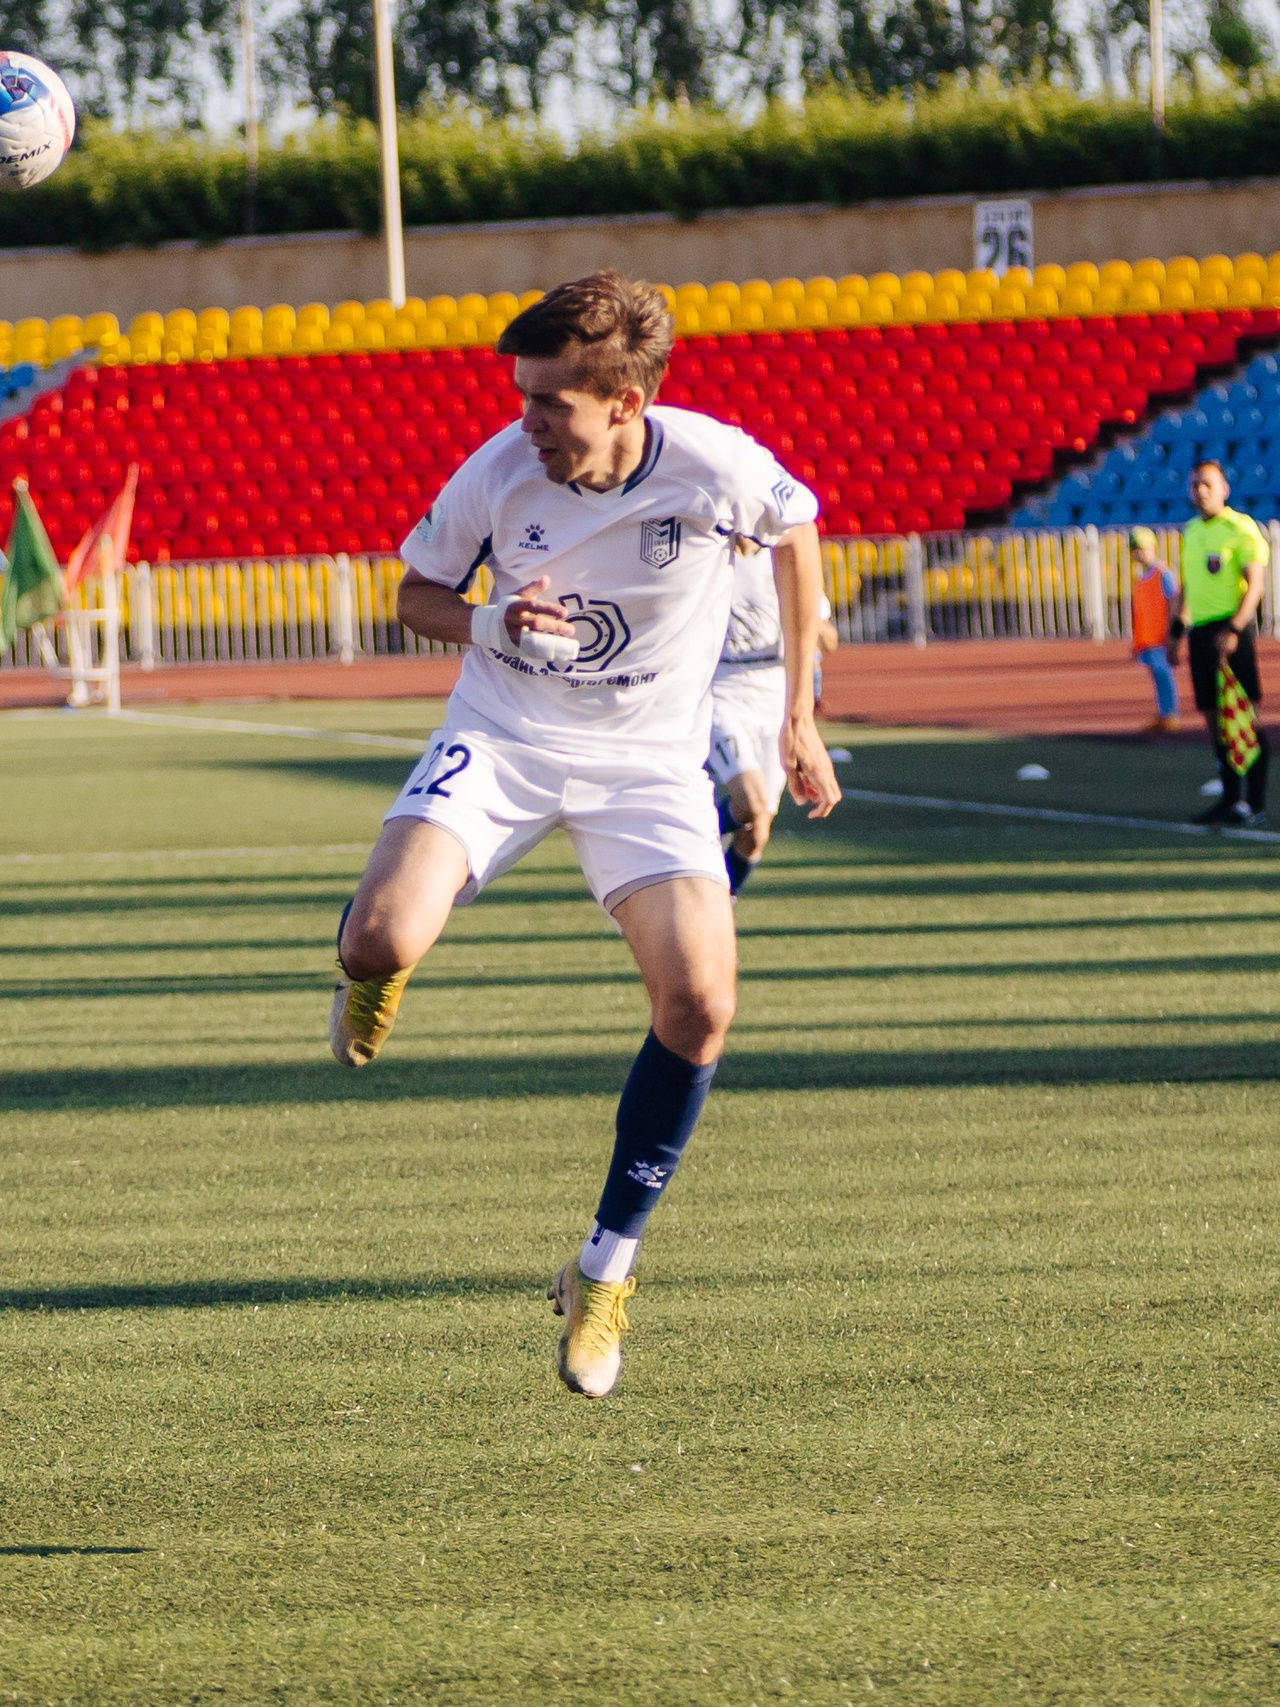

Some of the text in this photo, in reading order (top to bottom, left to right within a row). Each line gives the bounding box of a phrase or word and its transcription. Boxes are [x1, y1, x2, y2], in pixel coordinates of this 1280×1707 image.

[518, 542, 550, 551] KELME
[715, 736, 739, 765] 17
[406, 742, 471, 799] 22
[627, 1169, 662, 1188] KELME
